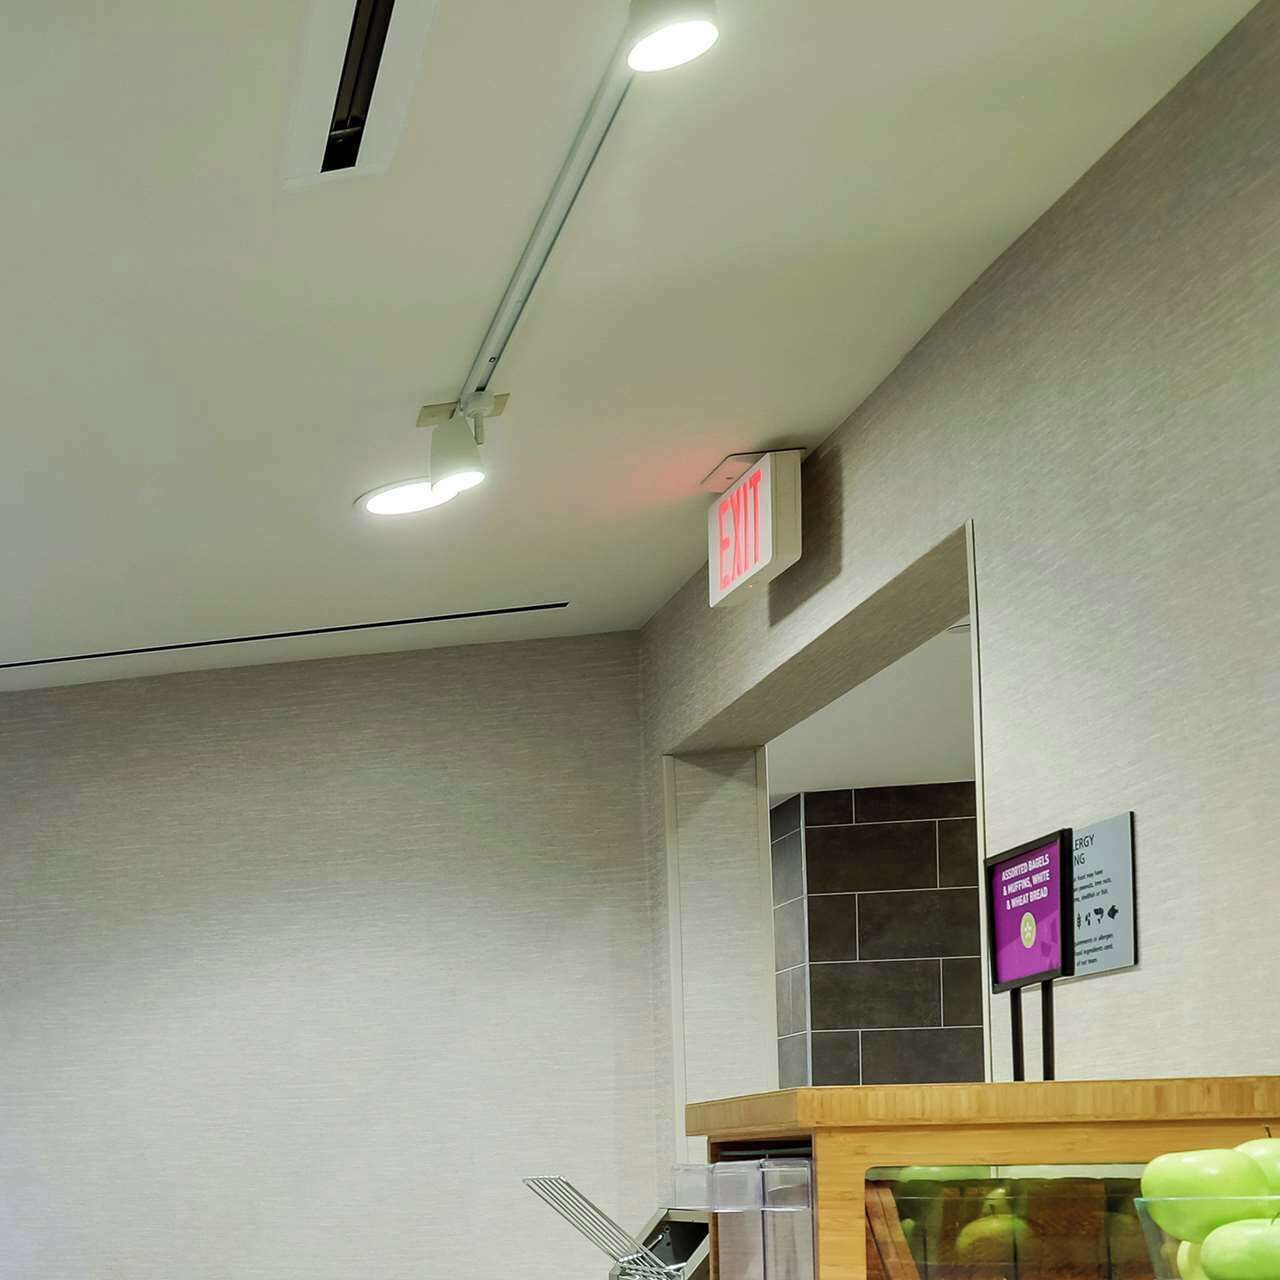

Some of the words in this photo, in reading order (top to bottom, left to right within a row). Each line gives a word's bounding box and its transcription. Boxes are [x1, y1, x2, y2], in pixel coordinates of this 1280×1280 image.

[719, 468, 763, 592] EXIT
[1073, 833, 1095, 851] ERGY
[1001, 862, 1028, 881] ASSORTED
[1028, 853, 1050, 871] BAGELS
[1002, 885, 1008, 896] &
[1032, 869, 1050, 886] WHITE
[1006, 899, 1011, 910] &
[1010, 893, 1029, 909] WHEAT
[1029, 886, 1049, 902] BREAD
